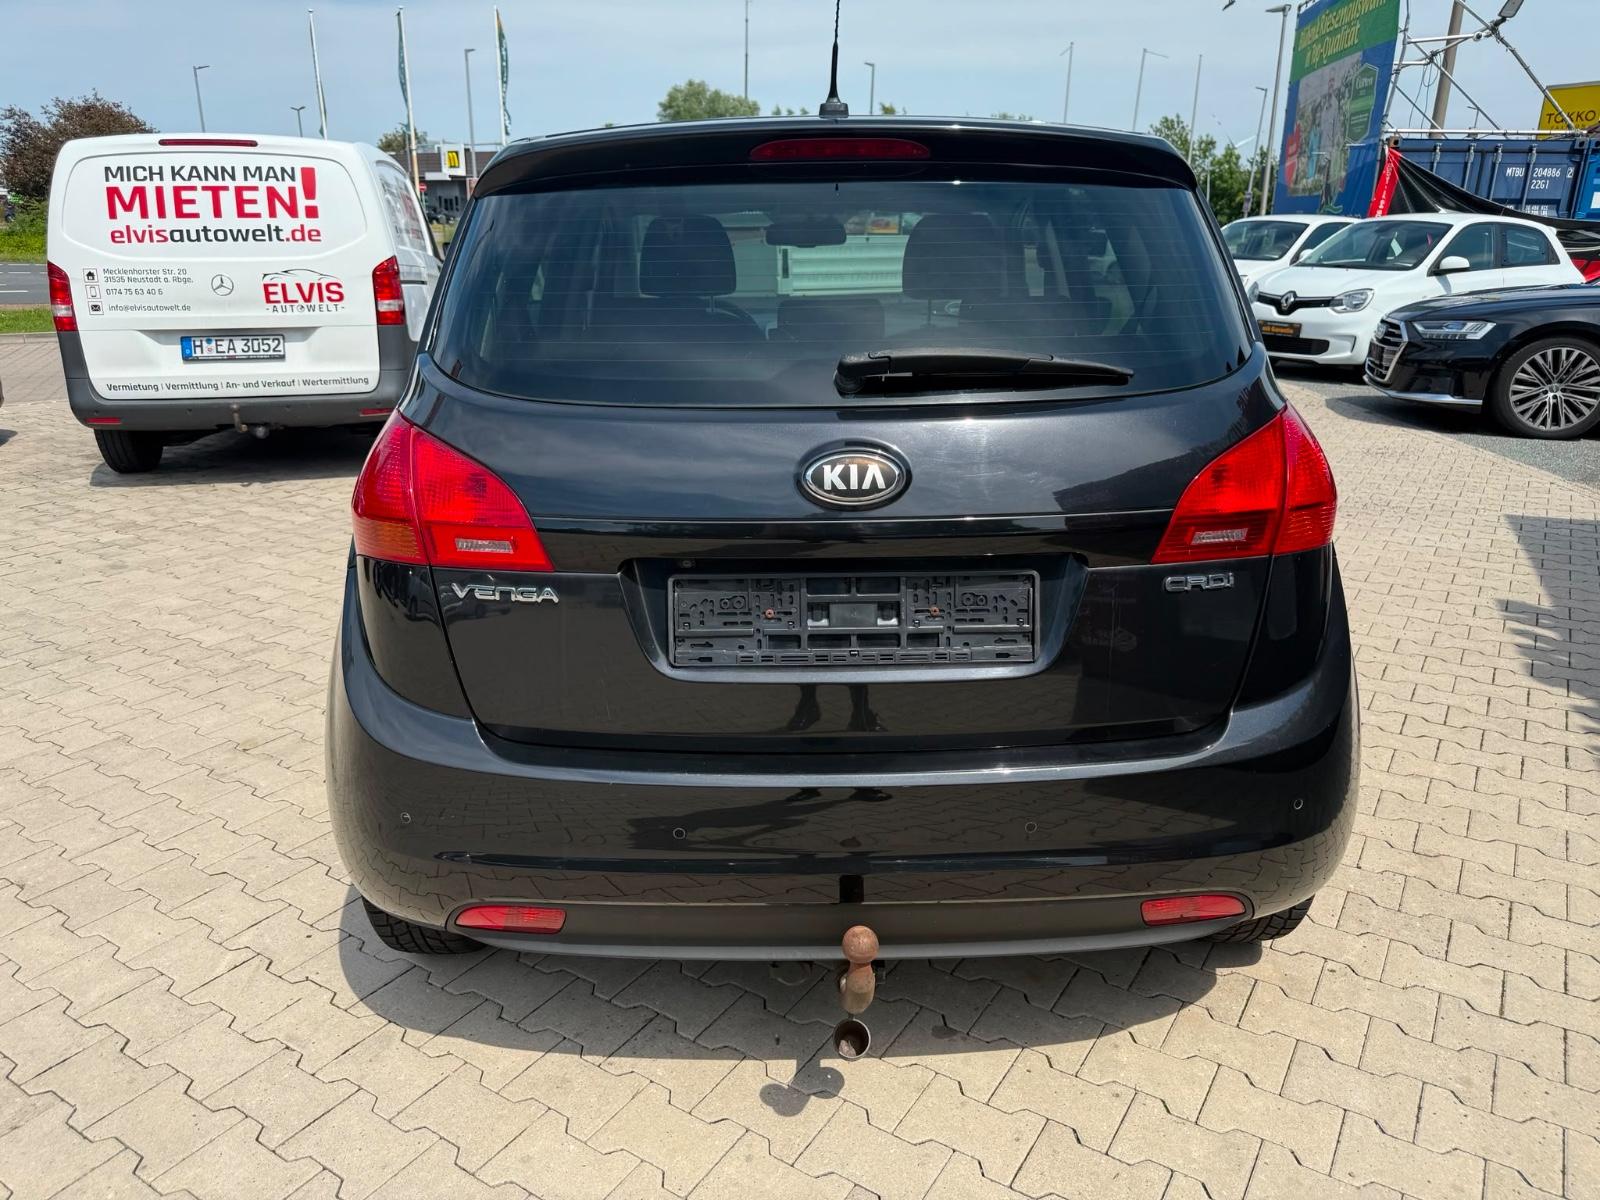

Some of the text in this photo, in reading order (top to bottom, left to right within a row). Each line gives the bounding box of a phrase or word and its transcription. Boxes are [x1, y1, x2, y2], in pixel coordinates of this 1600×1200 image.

[104, 165, 296, 182] MICH KANN MAN
[1505, 167, 1526, 178] MTBU
[106, 167, 320, 220] MIETEN!
[110, 223, 322, 244] elvisautowelt.de
[103, 268, 187, 276] Mecklenhorster Str. 20
[103, 276, 126, 284] 31535
[127, 276, 162, 284] Neustadt
[172, 276, 194, 285] Rbge.
[106, 288, 123, 296] 0174
[124, 288, 133, 296] 75
[146, 288, 157, 296] 40
[263, 282, 345, 304] ELVIS
[108, 303, 192, 312] info@elvisautowelt.de
[193, 337, 282, 355] H EA 3052
[106, 376, 370, 393] Vermietung Vermittlung An- und Verkauf Wertermittlung
[822, 463, 887, 491] KIA
[451, 582, 560, 604] VENGA
